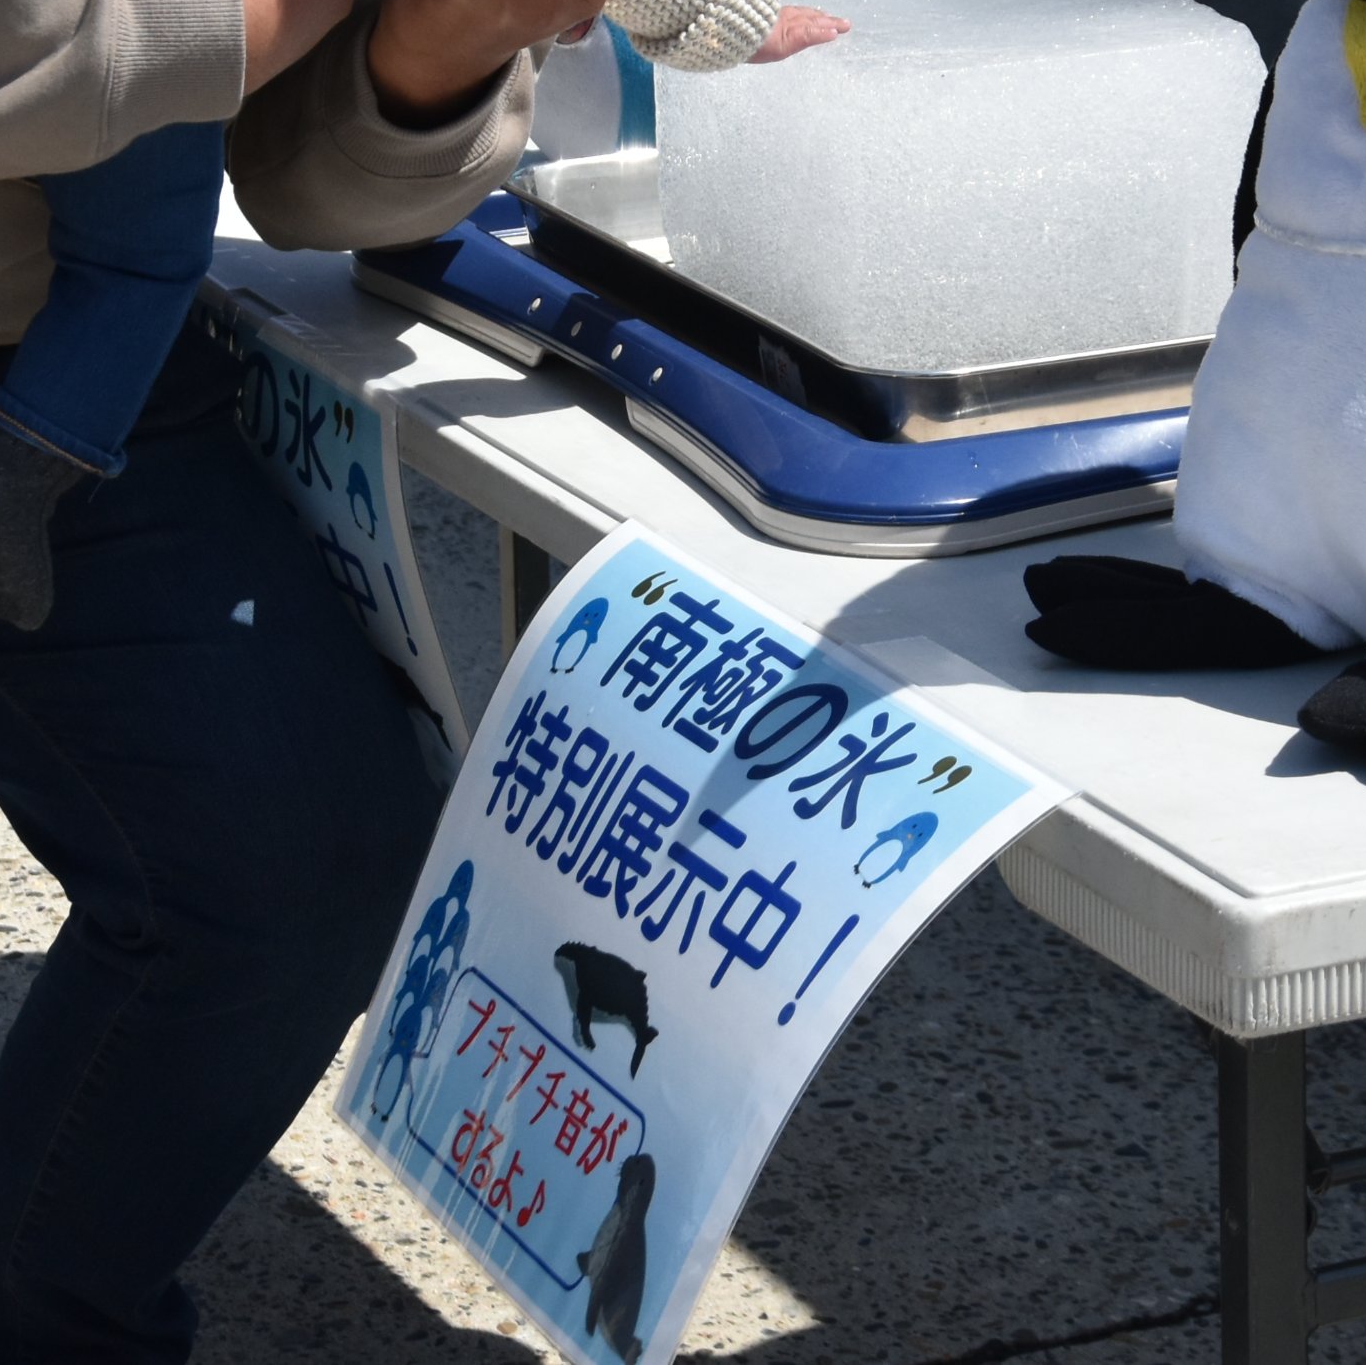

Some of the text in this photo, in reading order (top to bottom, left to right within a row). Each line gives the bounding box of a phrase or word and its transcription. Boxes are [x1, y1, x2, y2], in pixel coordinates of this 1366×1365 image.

[485, 690, 860, 1026] 特別展示中！
[457, 999, 628, 1175] プチプチ音が
